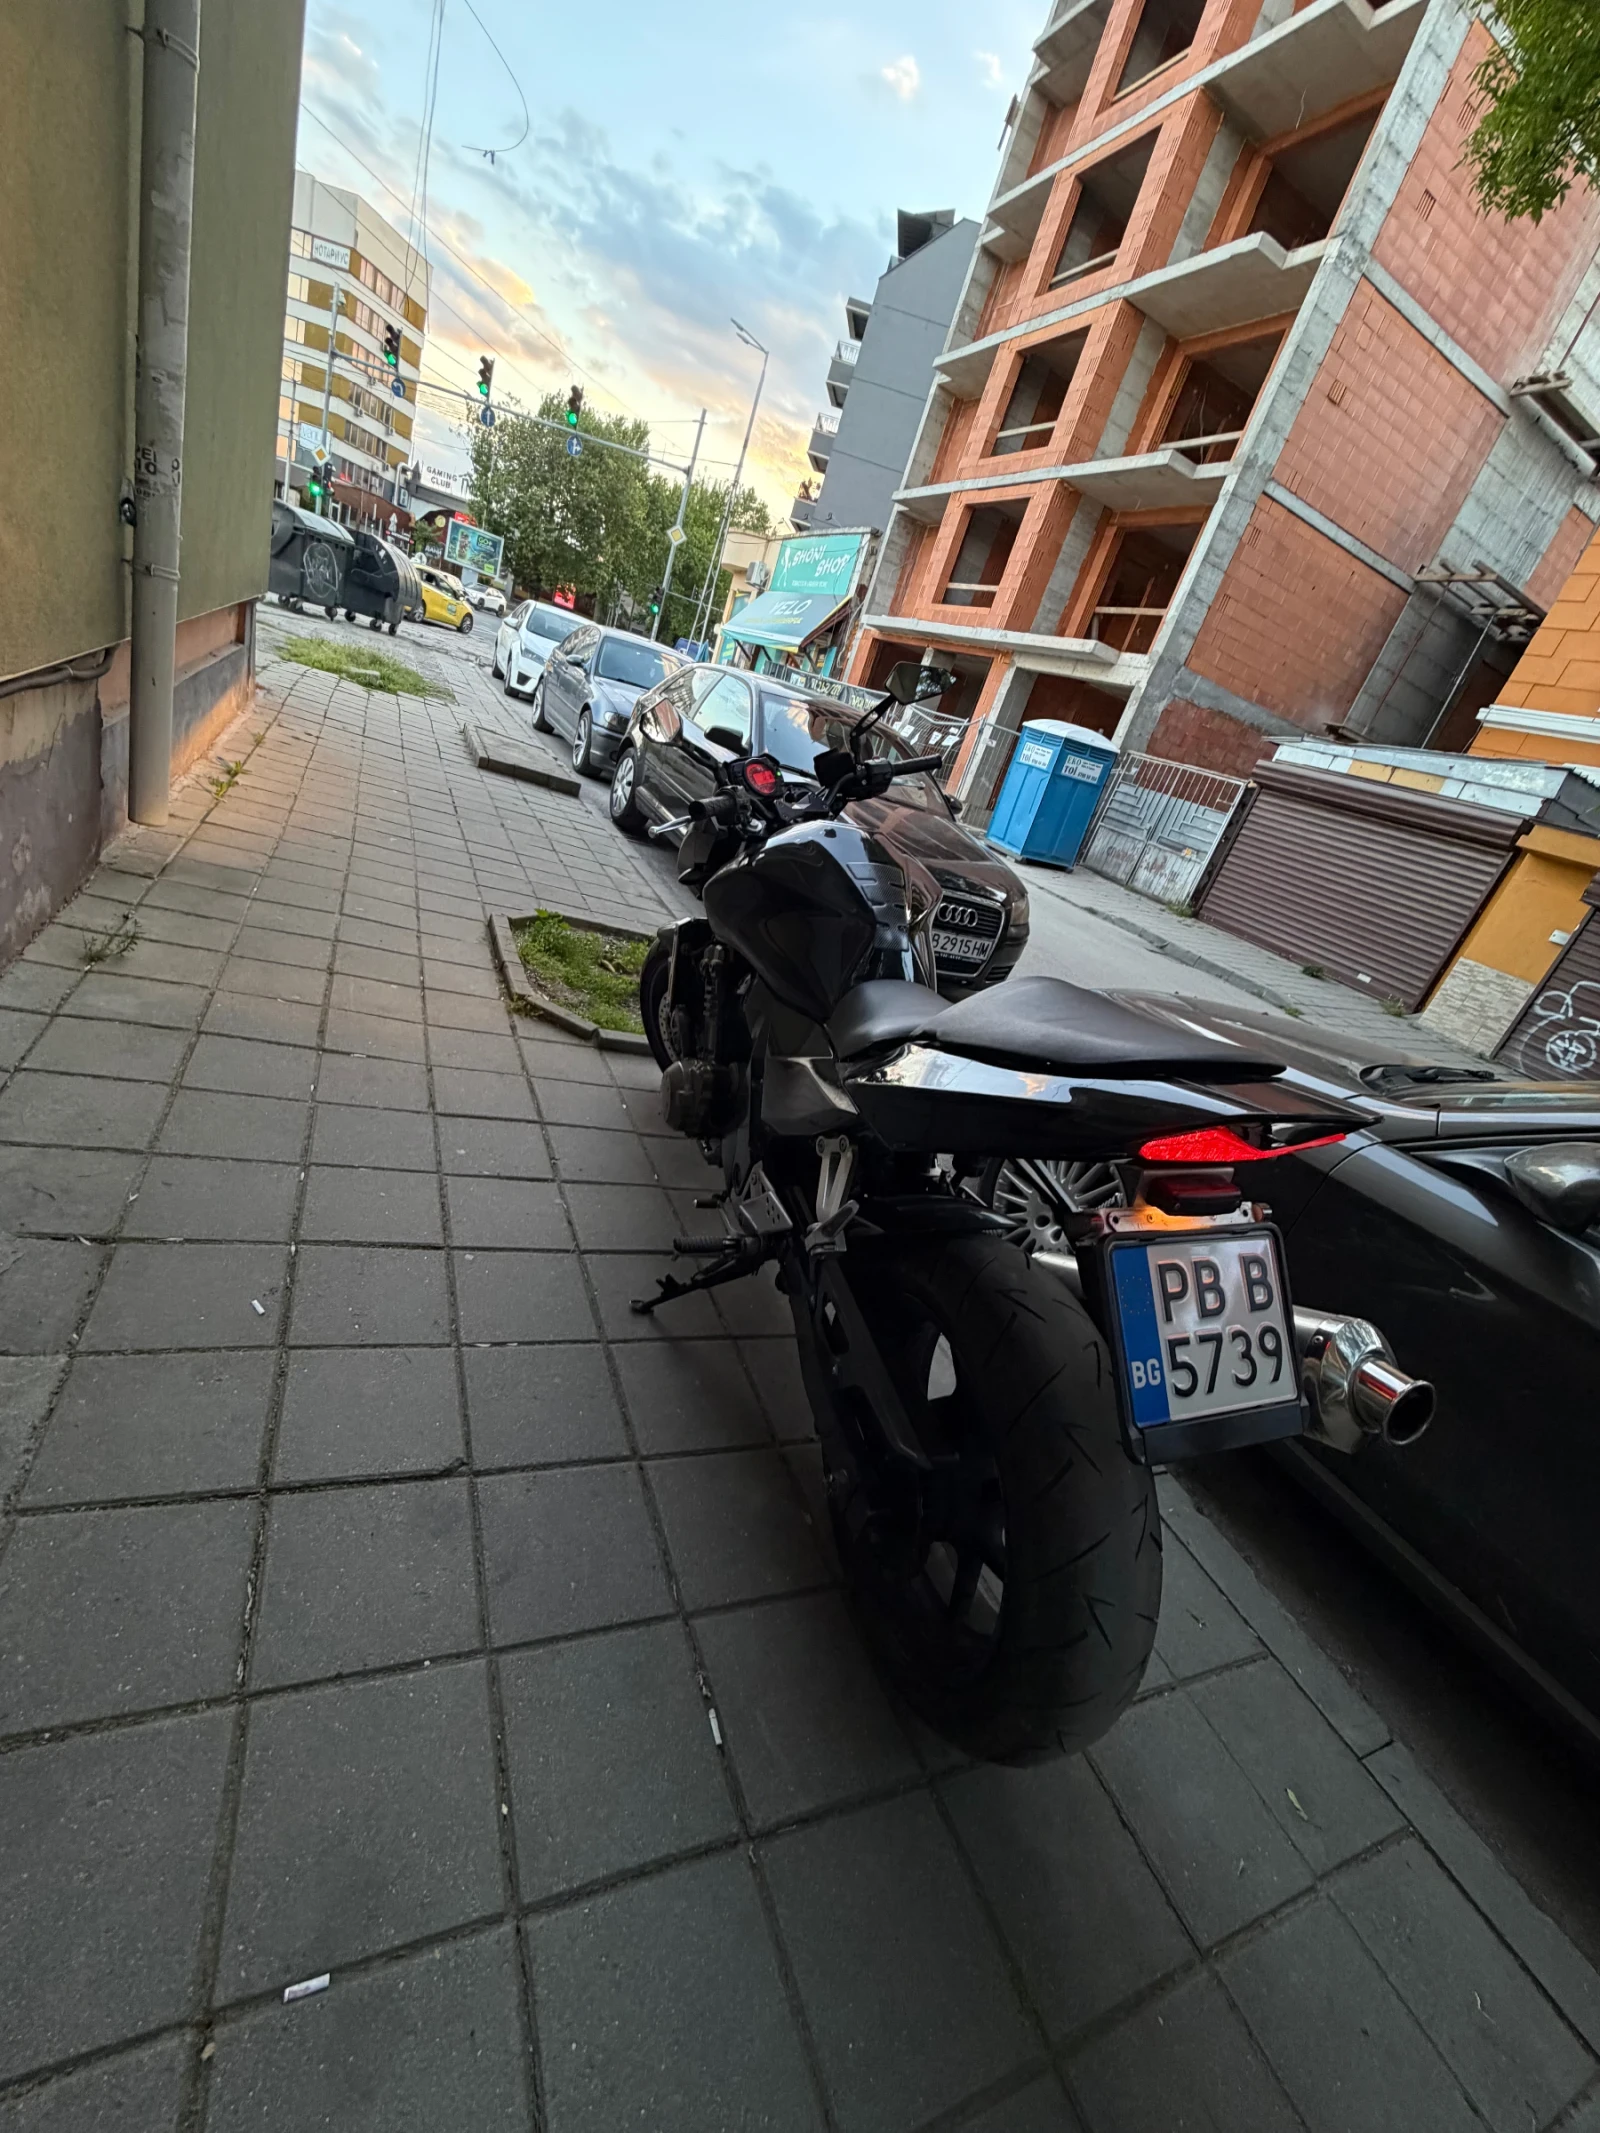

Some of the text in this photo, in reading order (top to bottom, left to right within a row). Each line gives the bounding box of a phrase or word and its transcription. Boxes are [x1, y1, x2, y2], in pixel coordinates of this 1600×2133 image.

[314, 243, 349, 265] НОТАРИУС
[426, 465, 458, 482] GAMING
[430, 476, 451, 489] CLUB
[791, 544, 828, 566] SHONI
[814, 553, 851, 577] SHOP
[940, 936, 973, 954] 2915
[971, 941, 990, 958] HM
[1156, 1252, 1274, 1323] PB B
[1166, 1321, 1283, 1398] 5739
[1131, 1358, 1162, 1389] BG
